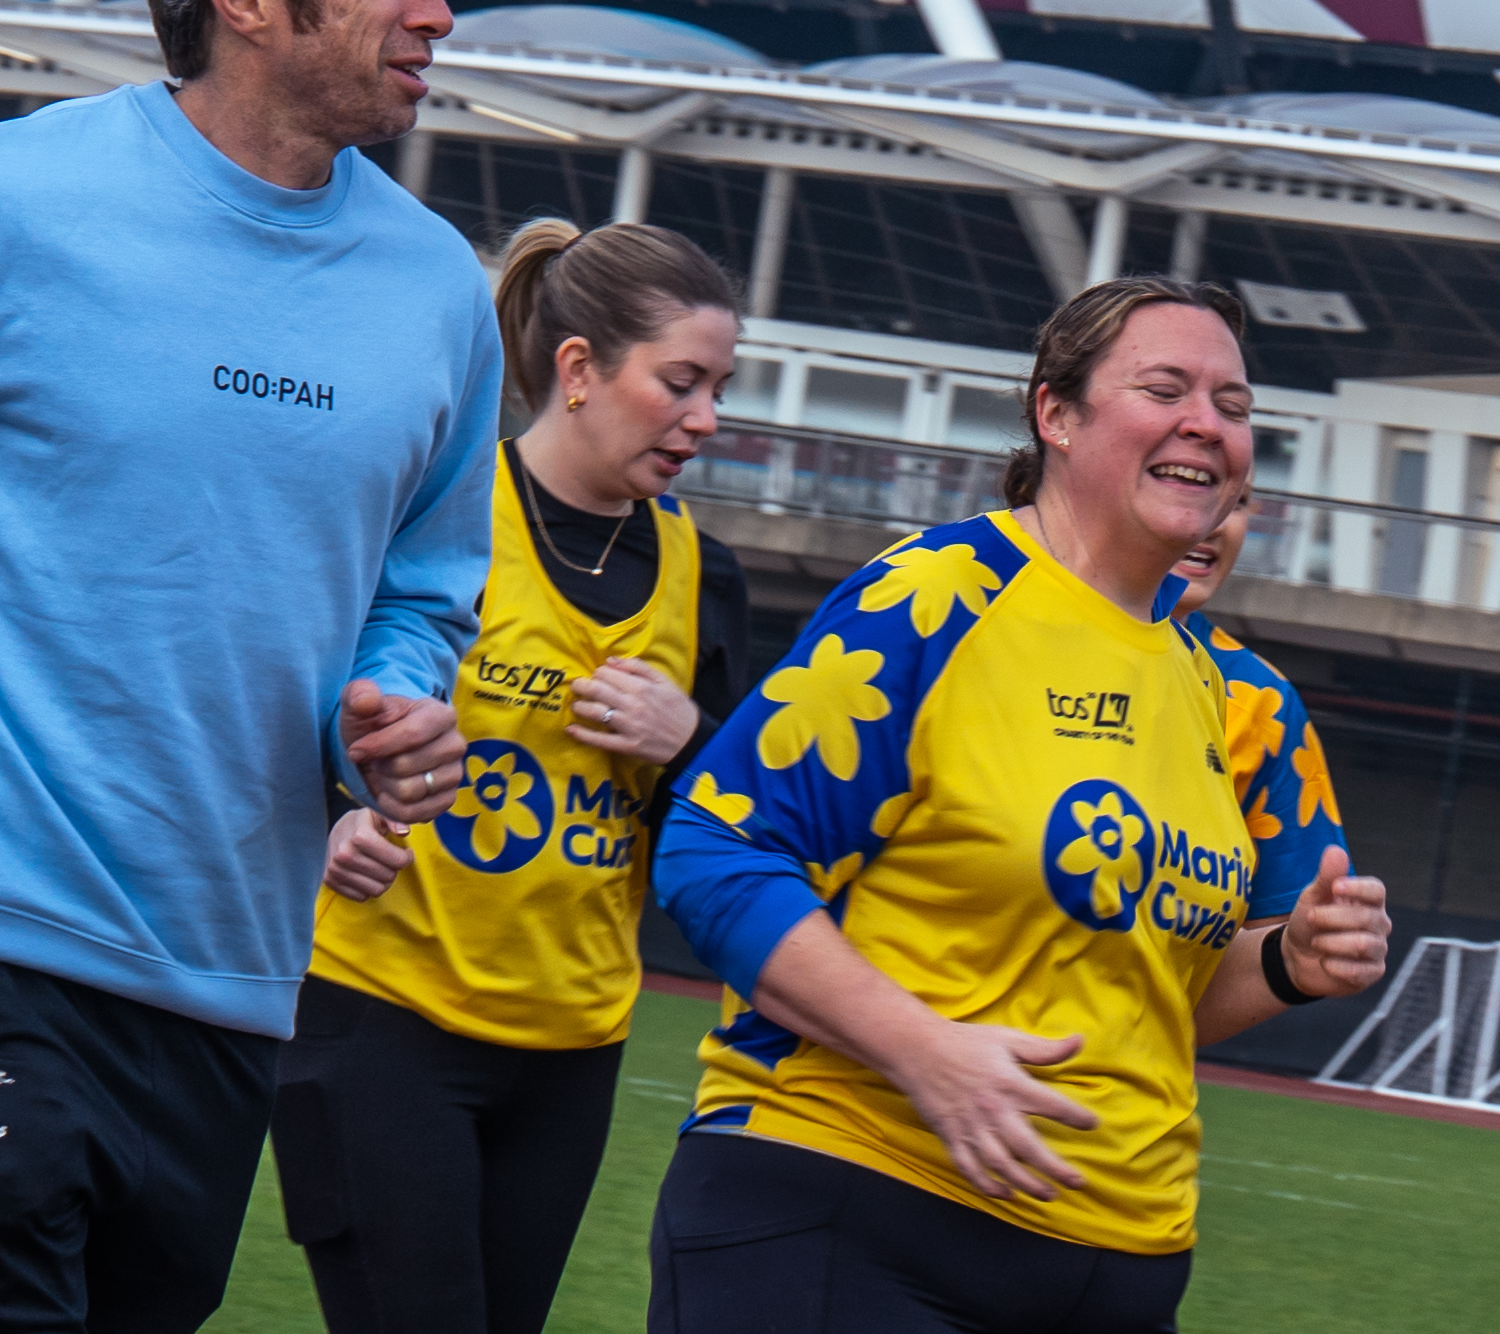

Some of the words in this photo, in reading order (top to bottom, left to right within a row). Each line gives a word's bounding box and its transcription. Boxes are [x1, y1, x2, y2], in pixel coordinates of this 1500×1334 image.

[213, 365, 334, 411] COO:PAH
[478, 654, 519, 687] tcs
[1046, 687, 1089, 720] tcs
[1151, 880, 1238, 950] Curie
